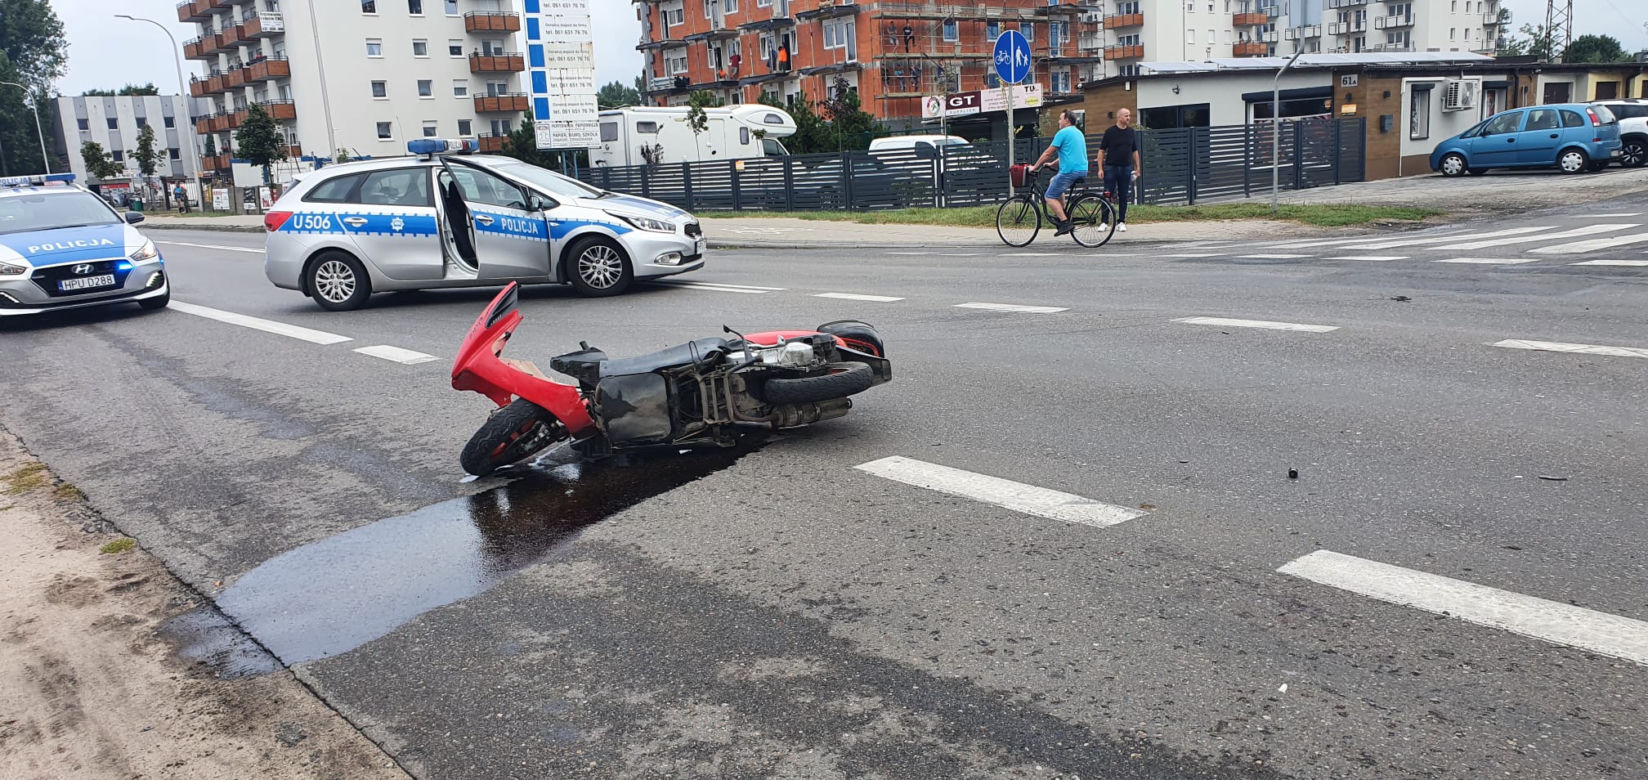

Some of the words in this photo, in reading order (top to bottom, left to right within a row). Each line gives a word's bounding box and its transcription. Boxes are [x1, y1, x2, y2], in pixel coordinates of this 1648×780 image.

[1343, 77, 1356, 85] 61A
[950, 95, 975, 107] GT
[294, 215, 303, 229] U
[305, 215, 331, 230] 506
[501, 217, 539, 235] POLICJA
[29, 238, 114, 253] POLICJA
[64, 279, 85, 290] HPU
[88, 276, 113, 287] D288
